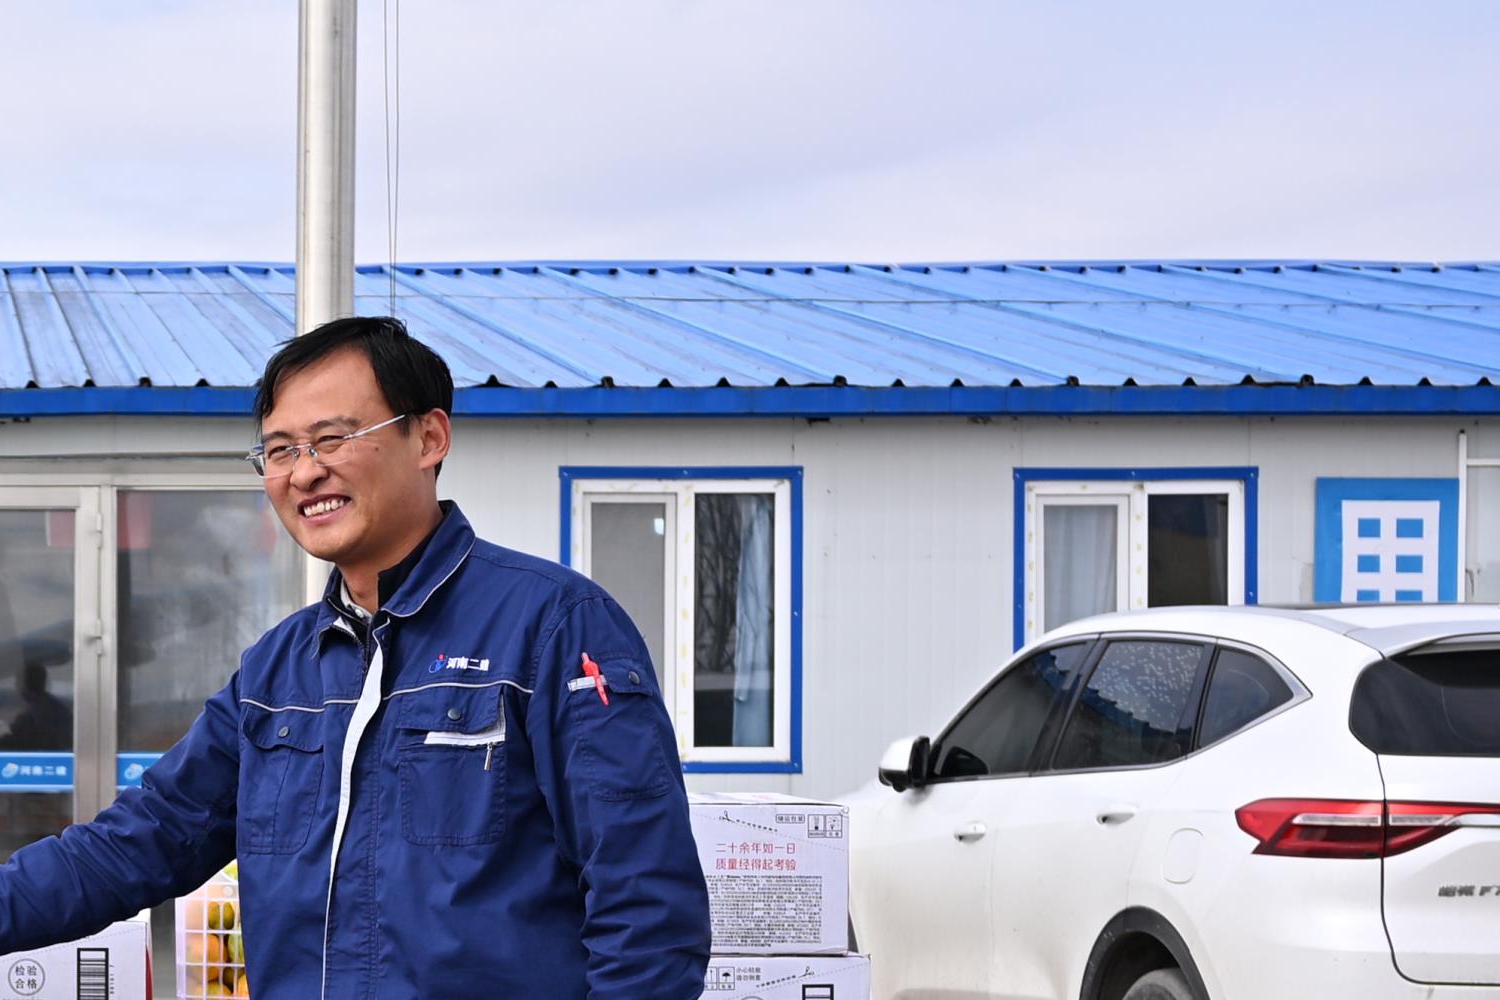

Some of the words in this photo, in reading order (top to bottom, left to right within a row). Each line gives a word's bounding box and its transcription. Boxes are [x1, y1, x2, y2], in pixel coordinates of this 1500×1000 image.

[715, 842, 796, 854] 二十余年如一日
[715, 858, 797, 871] 质量经得起考验
[15, 965, 38, 976] 检验
[15, 978, 38, 990] 合格
